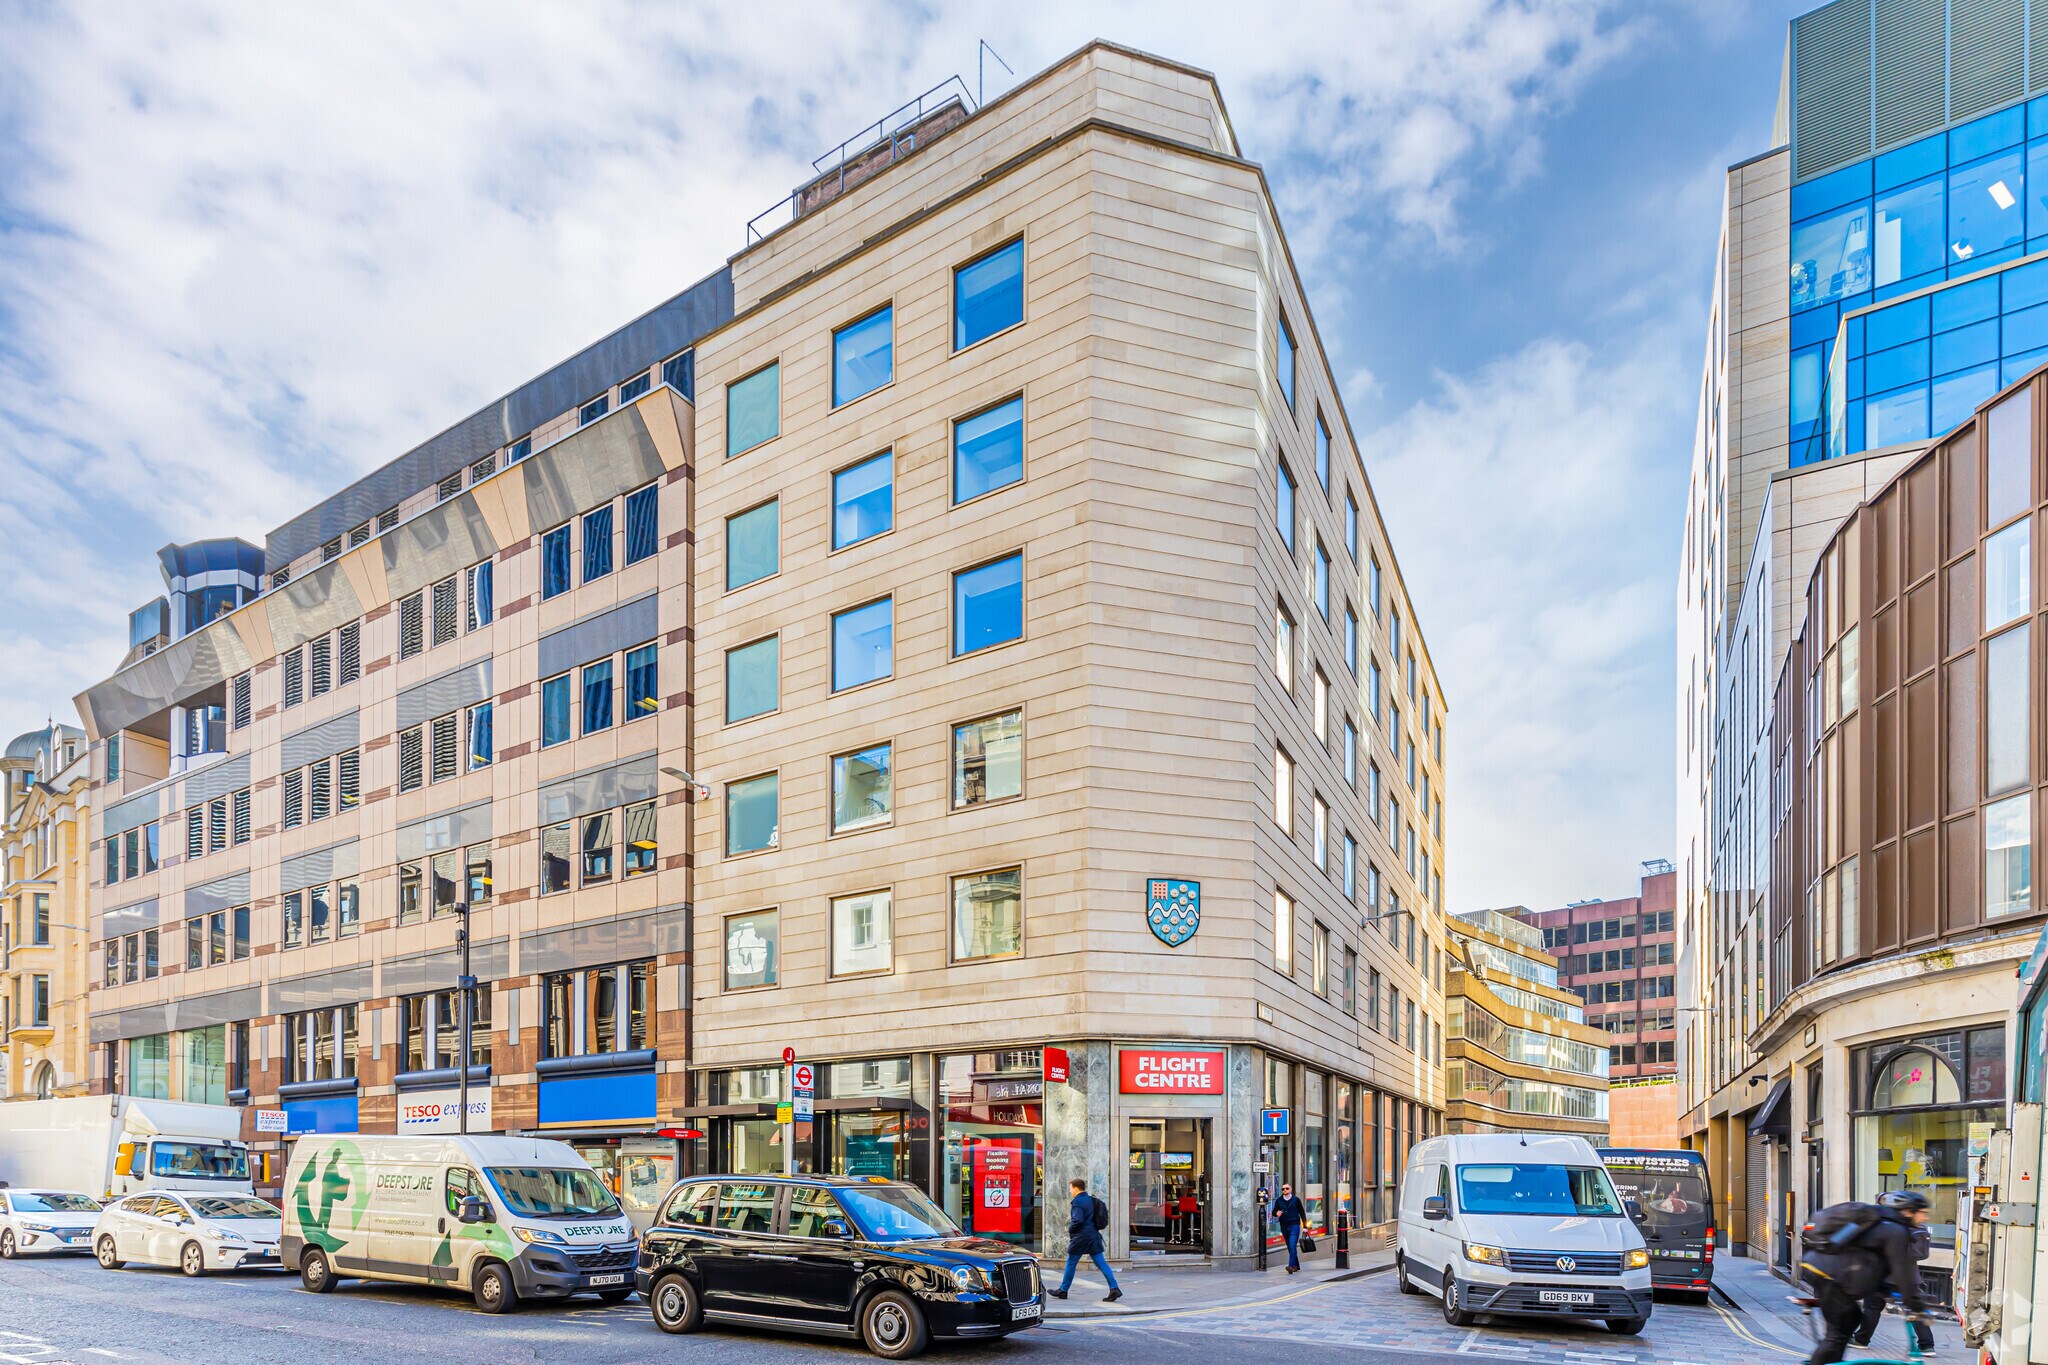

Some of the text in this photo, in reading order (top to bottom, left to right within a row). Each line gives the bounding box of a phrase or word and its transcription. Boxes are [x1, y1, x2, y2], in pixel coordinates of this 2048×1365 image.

[786, 1050, 792, 1061] J
[1139, 1057, 1208, 1072] FLIGHT
[1134, 1073, 1211, 1088] CENTRE
[404, 1104, 440, 1118] TESCO
[1603, 1156, 1690, 1167] BIRTWISTLES
[376, 1174, 433, 1190] DEEPSTORE
[564, 1226, 625, 1236] DEEPSTORE
[1544, 1293, 1568, 1301] GD69
